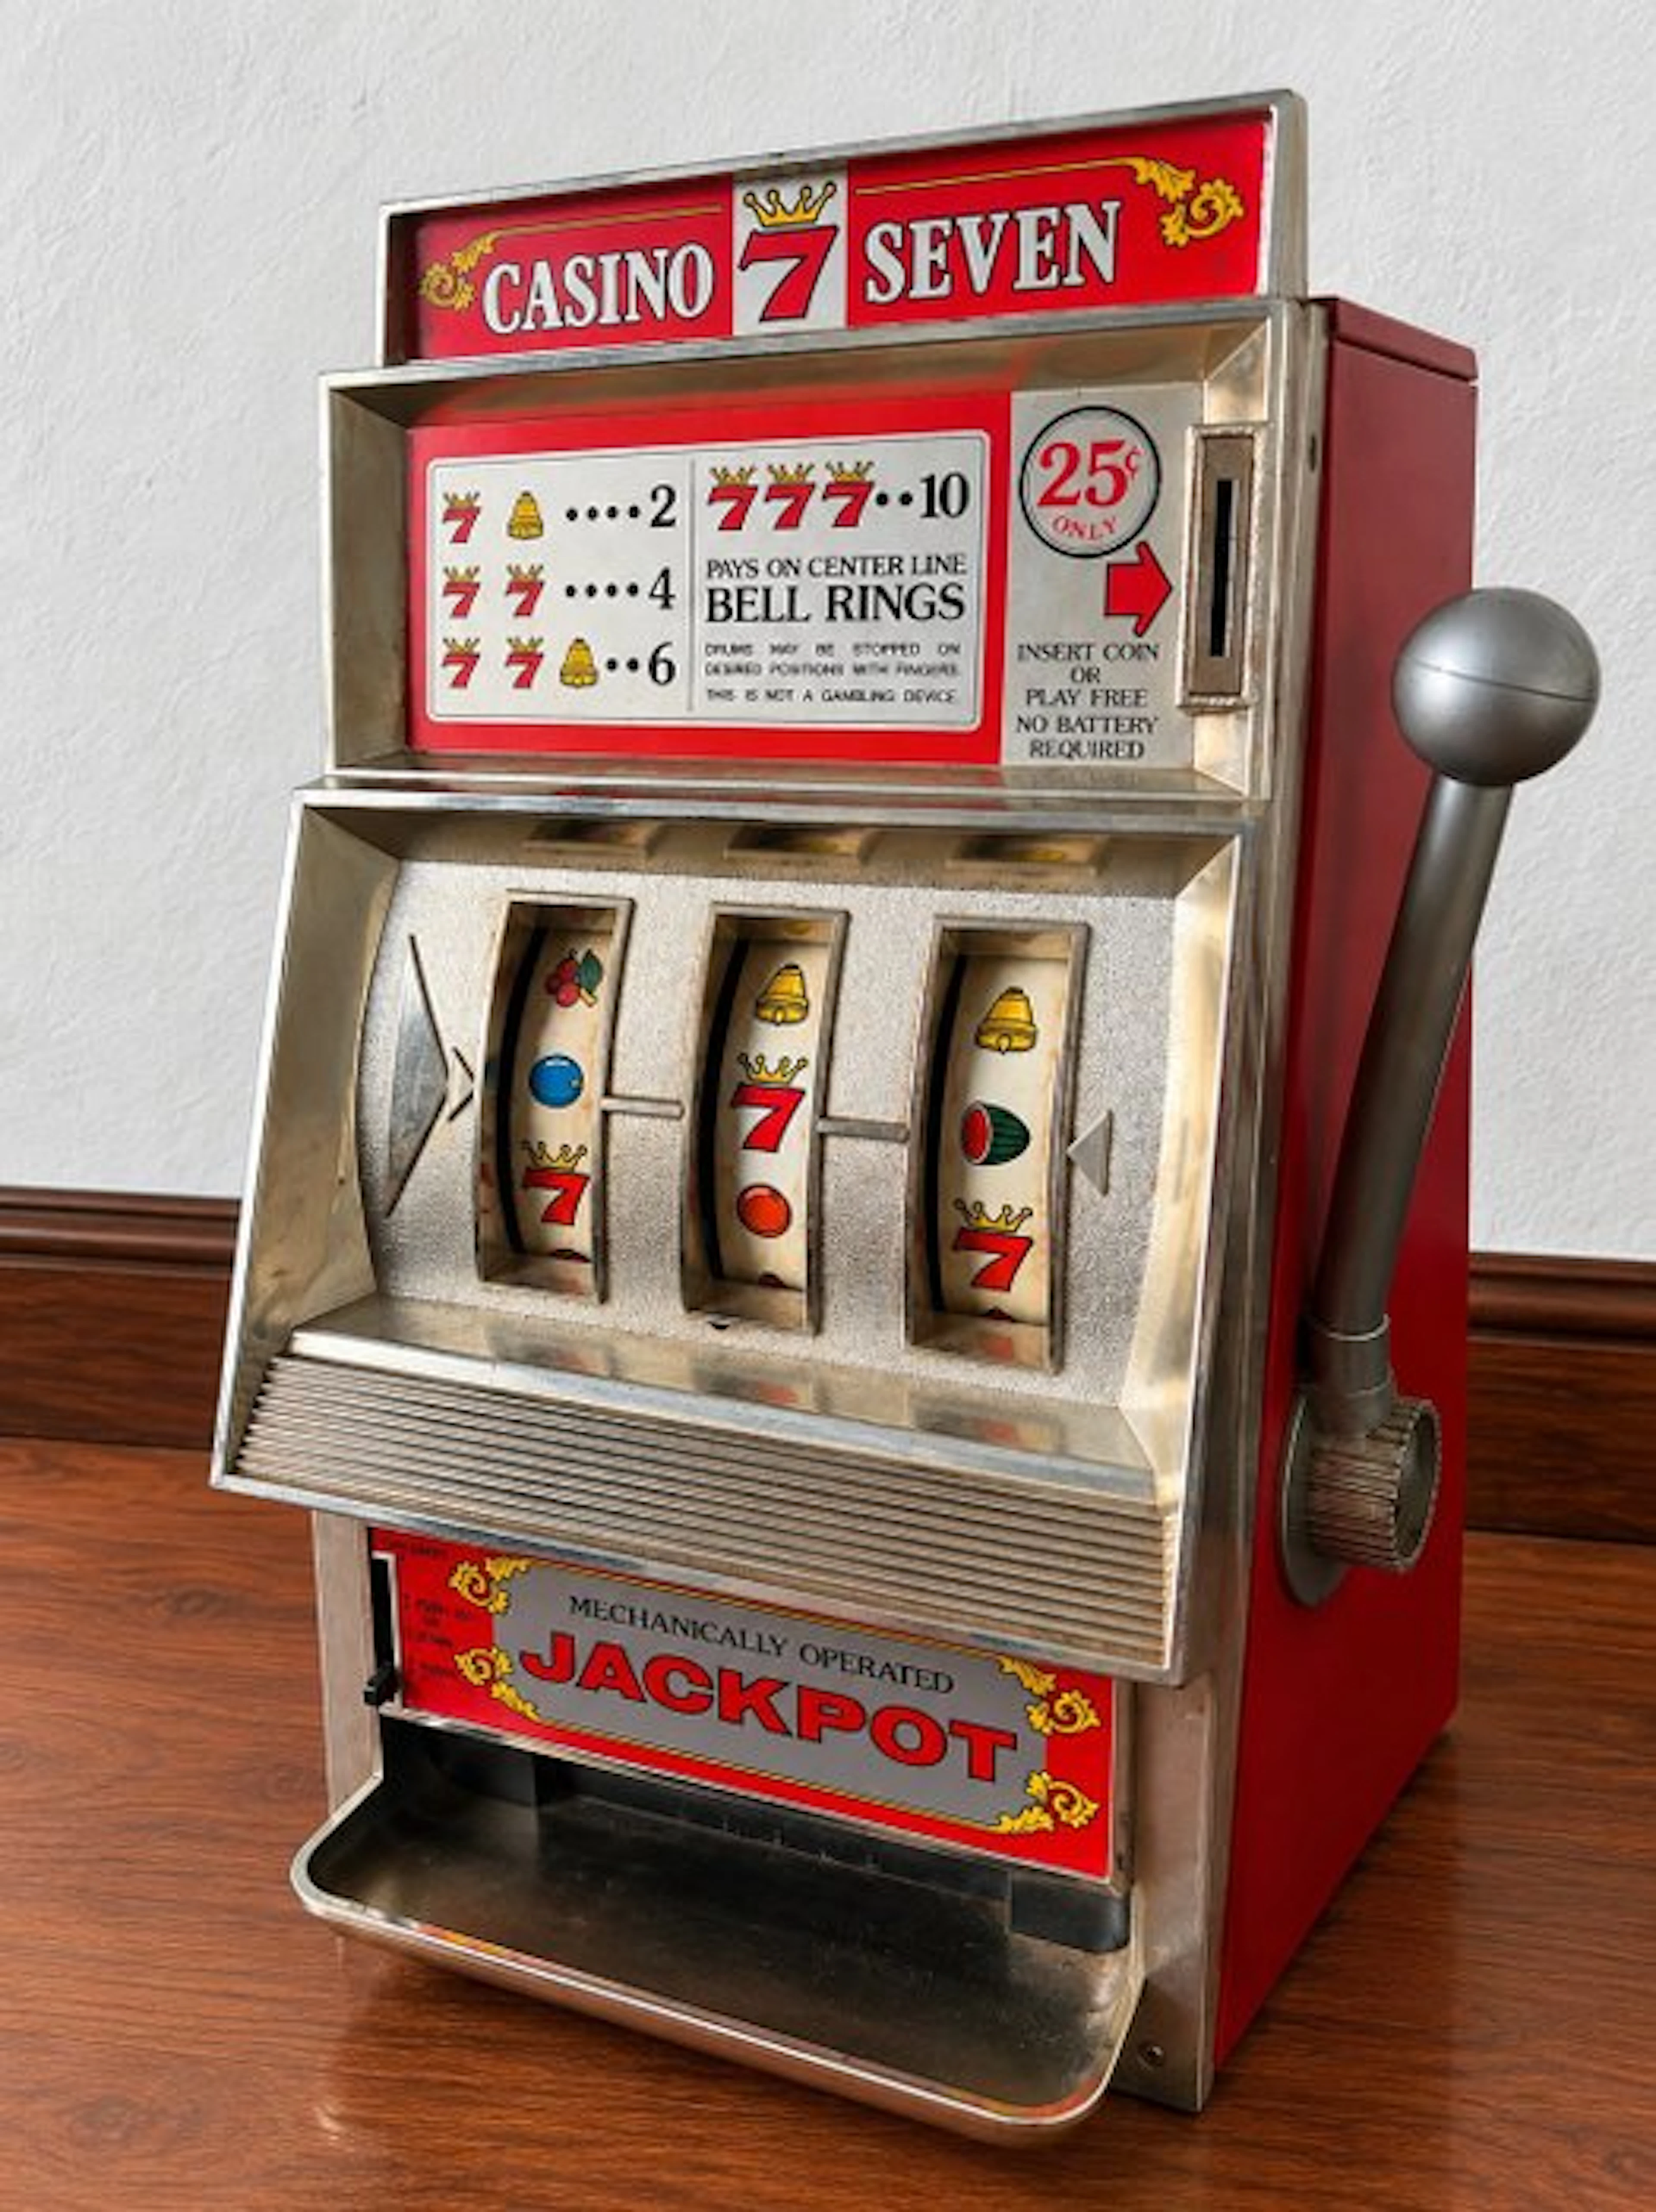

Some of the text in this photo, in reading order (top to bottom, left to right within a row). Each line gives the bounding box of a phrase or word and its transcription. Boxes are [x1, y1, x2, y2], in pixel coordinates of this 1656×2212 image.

[483, 200, 1121, 336] CASINO 7 SEVEN
[1052, 516, 1117, 540] ONLY
[706, 554, 967, 579] PAYS ON CENTER LINE
[706, 582, 966, 622] BELL RINGS
[938, 642, 960, 656] ON
[1018, 644, 1160, 661] INSERT COIN
[1070, 667, 1101, 683] OR
[803, 689, 812, 702] A
[822, 689, 894, 702] GAMBLING
[1026, 689, 1147, 707] PLAY FREE
[1017, 715, 1160, 734] NO BATTERY
[1030, 739, 1145, 760] REQUIRED
[569, 1595, 954, 1695] MECHANICALLY OPERATED
[518, 1630, 1019, 1783] JACKPOT
